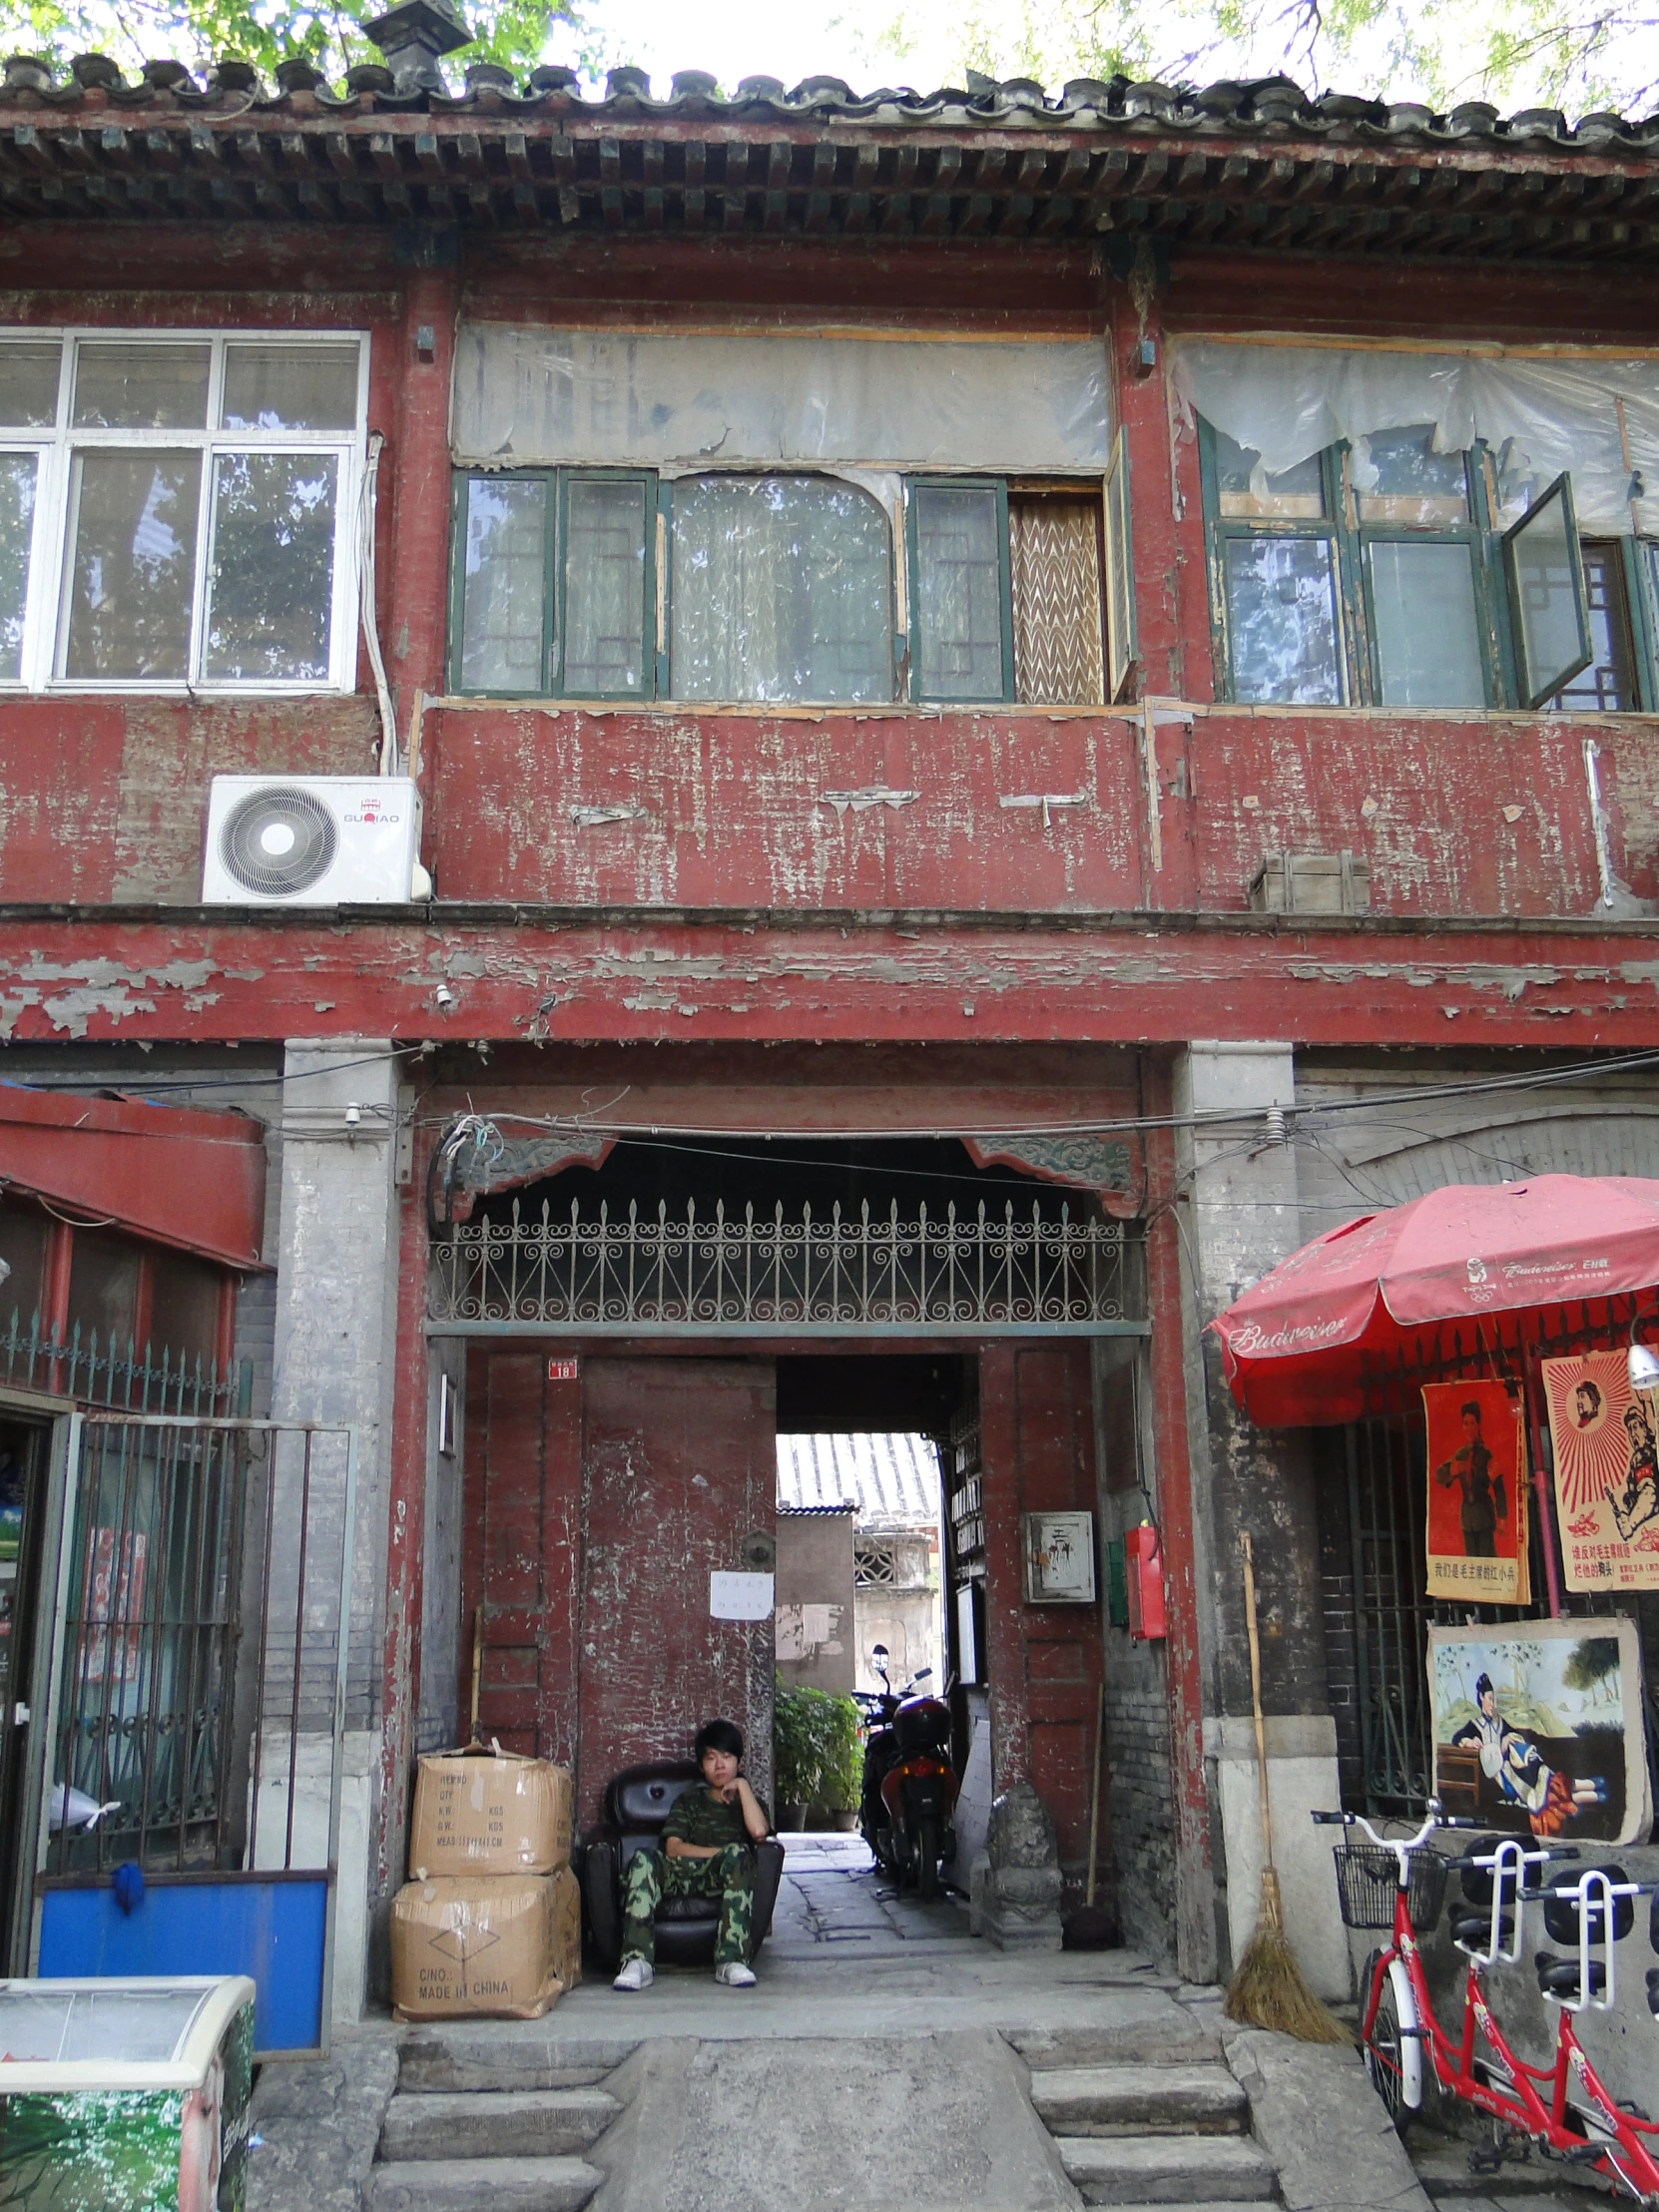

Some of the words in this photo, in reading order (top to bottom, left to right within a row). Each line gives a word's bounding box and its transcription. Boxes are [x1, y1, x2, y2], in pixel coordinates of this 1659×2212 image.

[343, 813, 400, 825] GUQIAO
[1501, 1262, 1576, 1279] Budweiser
[1228, 1316, 1348, 1353] Budweiser
[557, 1367, 570, 1378] 18
[1434, 1562, 1515, 1581] 我们是毛主席的红小兵
[488, 1806, 504, 1816] KGS
[488, 1821, 504, 1832] KGS
[491, 1837, 503, 1847] CM
[419, 1985, 450, 1999] MADE
[455, 1982, 468, 1998] IN
[472, 1980, 509, 1995] CHINA
